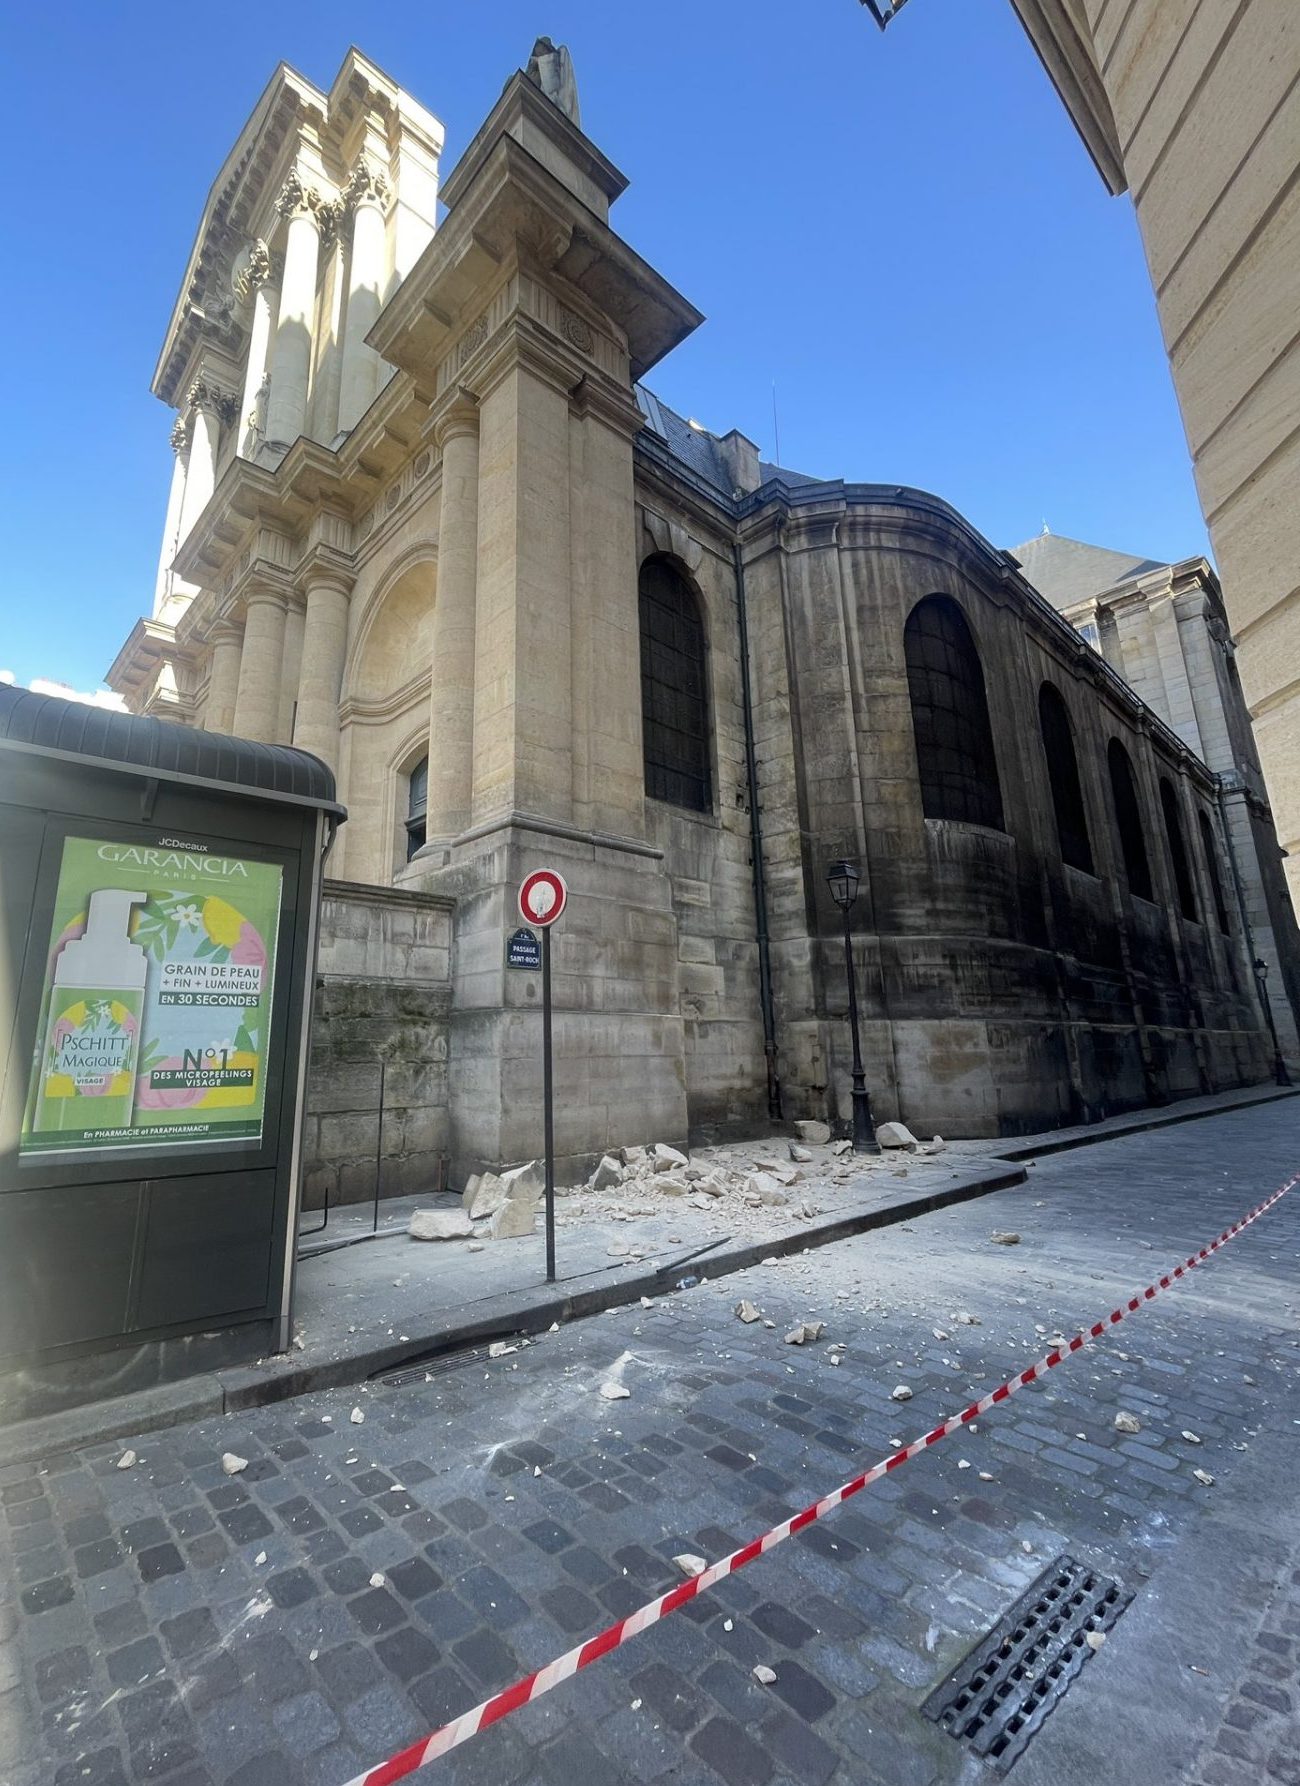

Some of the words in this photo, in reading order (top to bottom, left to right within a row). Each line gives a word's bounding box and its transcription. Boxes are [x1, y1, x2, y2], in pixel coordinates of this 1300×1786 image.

[158, 837, 209, 852] JCDecaux
[97, 845, 249, 877] GARANCIA
[153, 870, 197, 880] PARIS
[512, 945, 536, 953] PASSAGE
[164, 964, 207, 976] GRAIN
[211, 966, 227, 977] DE
[229, 967, 260, 979] PEAU
[173, 978, 191, 988] FIN
[205, 980, 259, 990] LUMINEUX
[161, 995, 175, 1004] EN
[178, 994, 192, 1004] 30
[195, 995, 258, 1007] SECONDES
[61, 1033, 129, 1051] PSCHITT
[62, 1054, 122, 1068] MAGIQUE
[153, 1071, 171, 1080] DES
[175, 1070, 252, 1079] MICROPEELINGS
[186, 1079, 221, 1087] VISAGE
[83, 1131, 93, 1139] En
[95, 1128, 140, 1138] PHARMACIE
[141, 1127, 149, 1136] et
[150, 1125, 210, 1135] PARAPHARMACIE
